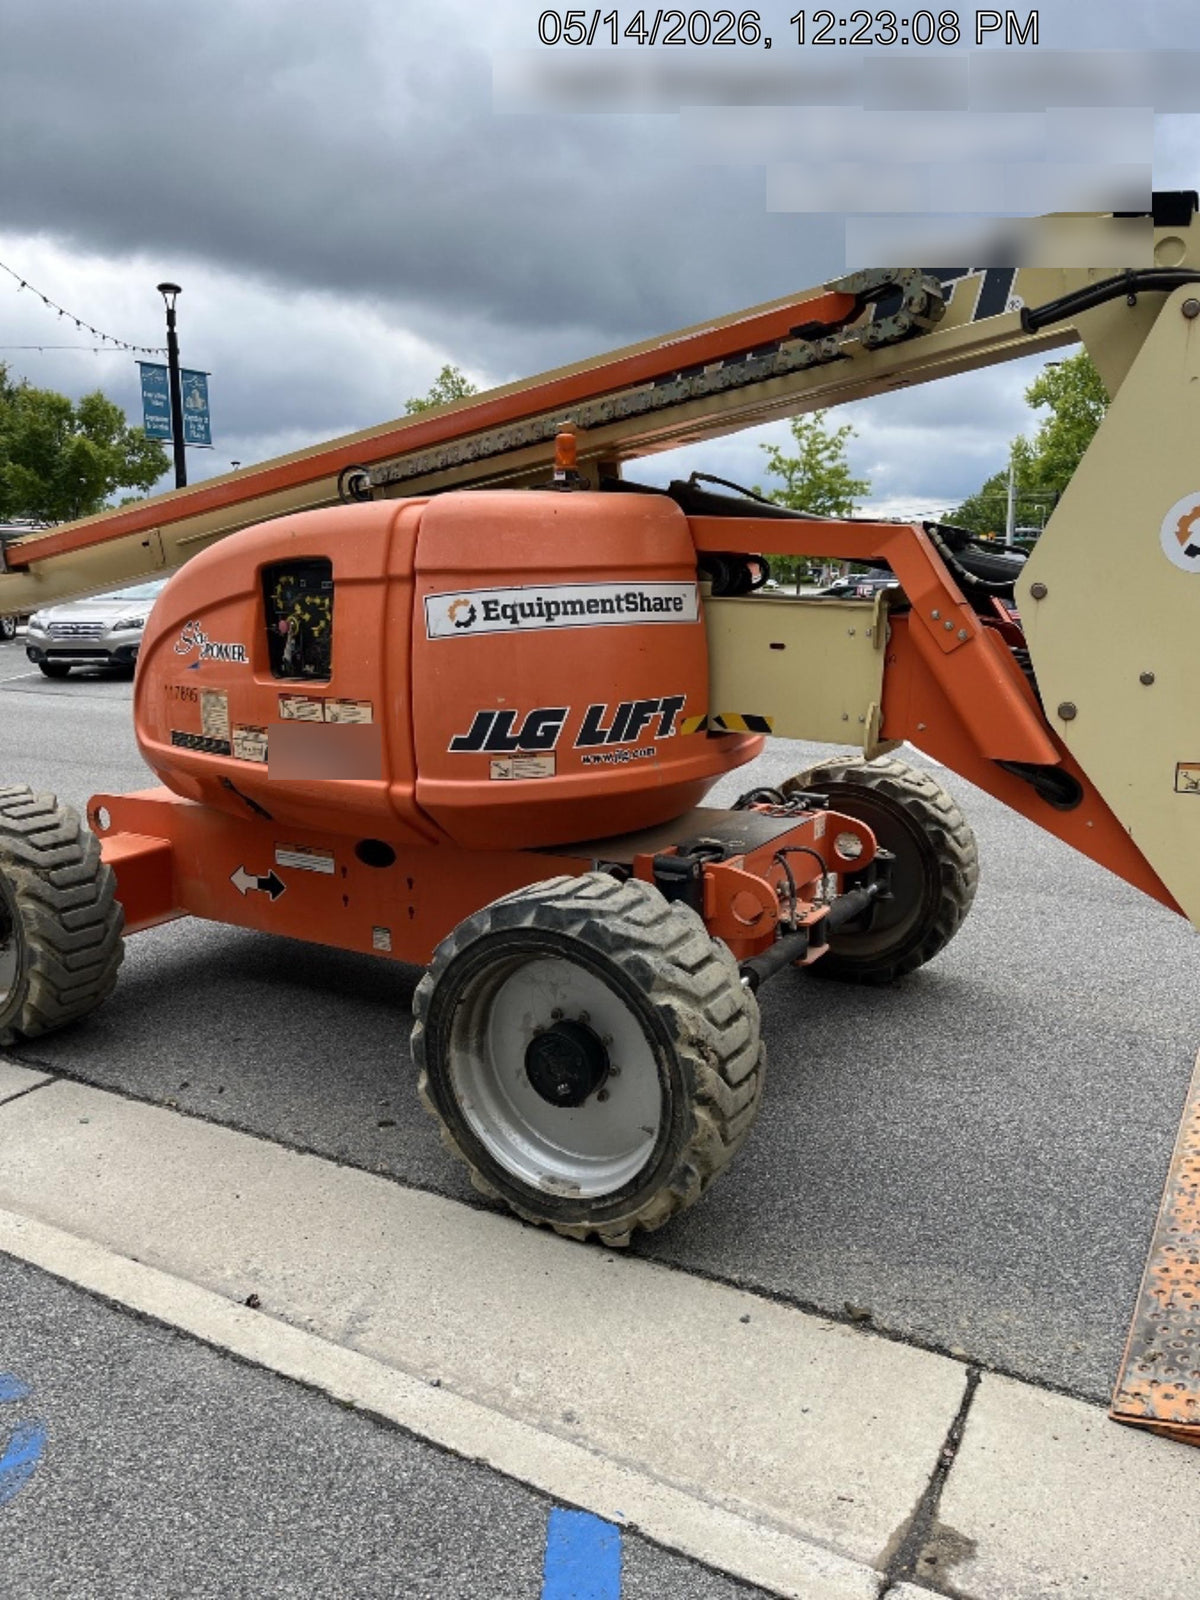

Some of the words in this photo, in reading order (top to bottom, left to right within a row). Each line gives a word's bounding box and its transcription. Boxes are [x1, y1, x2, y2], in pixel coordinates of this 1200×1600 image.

[481, 592, 684, 625] EquipmentShare
[447, 705, 570, 753] JLG
[572, 694, 687, 749] LIFT
[581, 746, 657, 765] www.jlg.com
